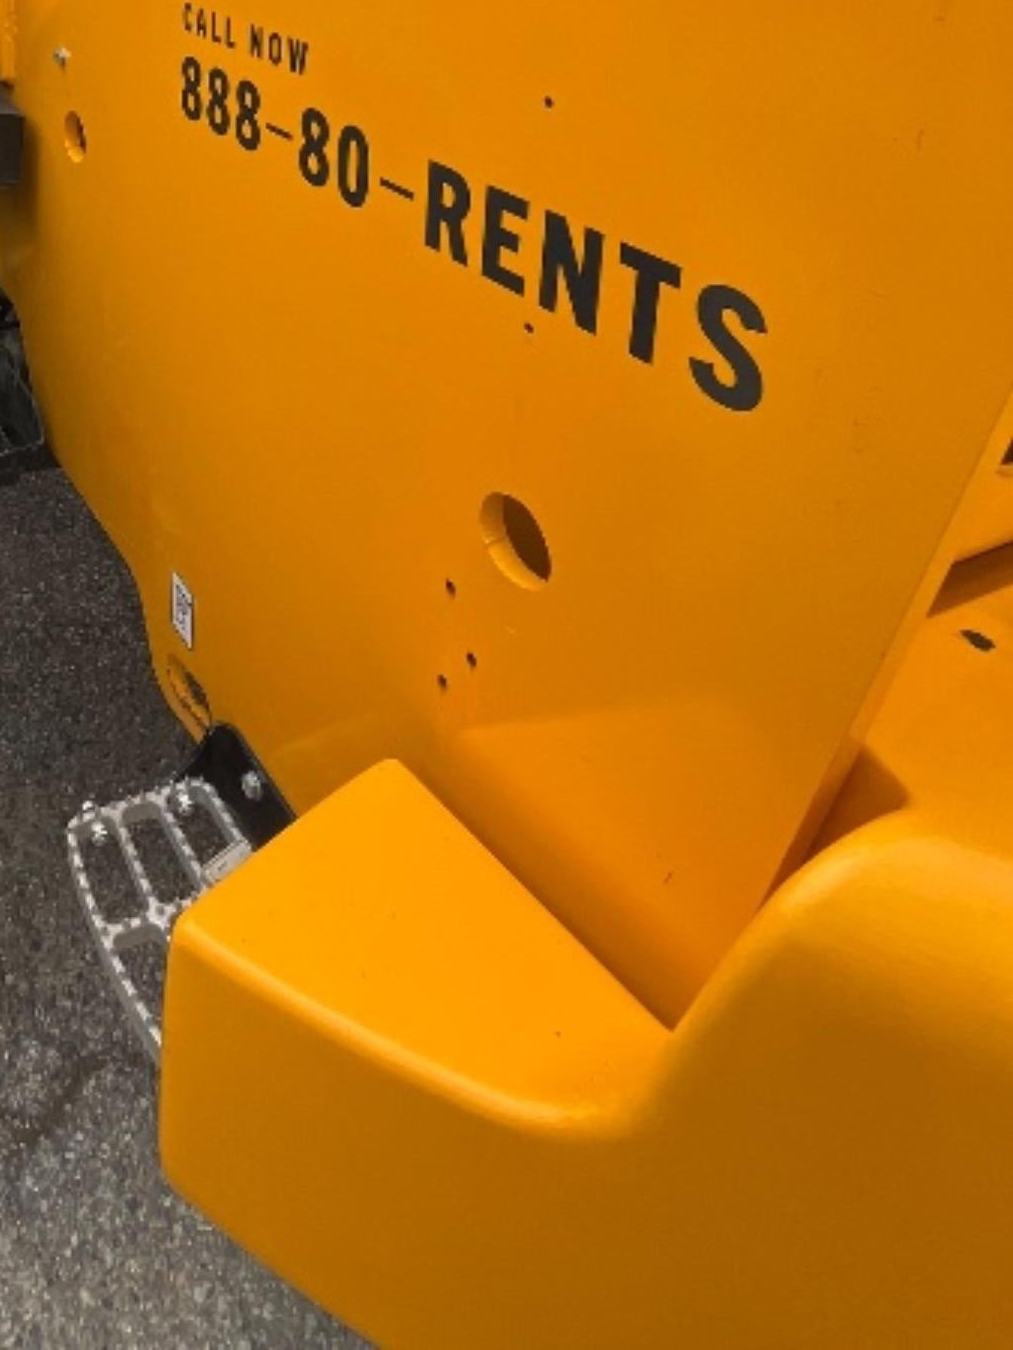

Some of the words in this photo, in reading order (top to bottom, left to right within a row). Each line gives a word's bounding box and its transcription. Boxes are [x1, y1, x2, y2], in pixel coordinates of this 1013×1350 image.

[183, 1, 236, 49] CALL
[250, 22, 309, 76] NOW
[181, 55, 768, 413] 888-80-RENTS
